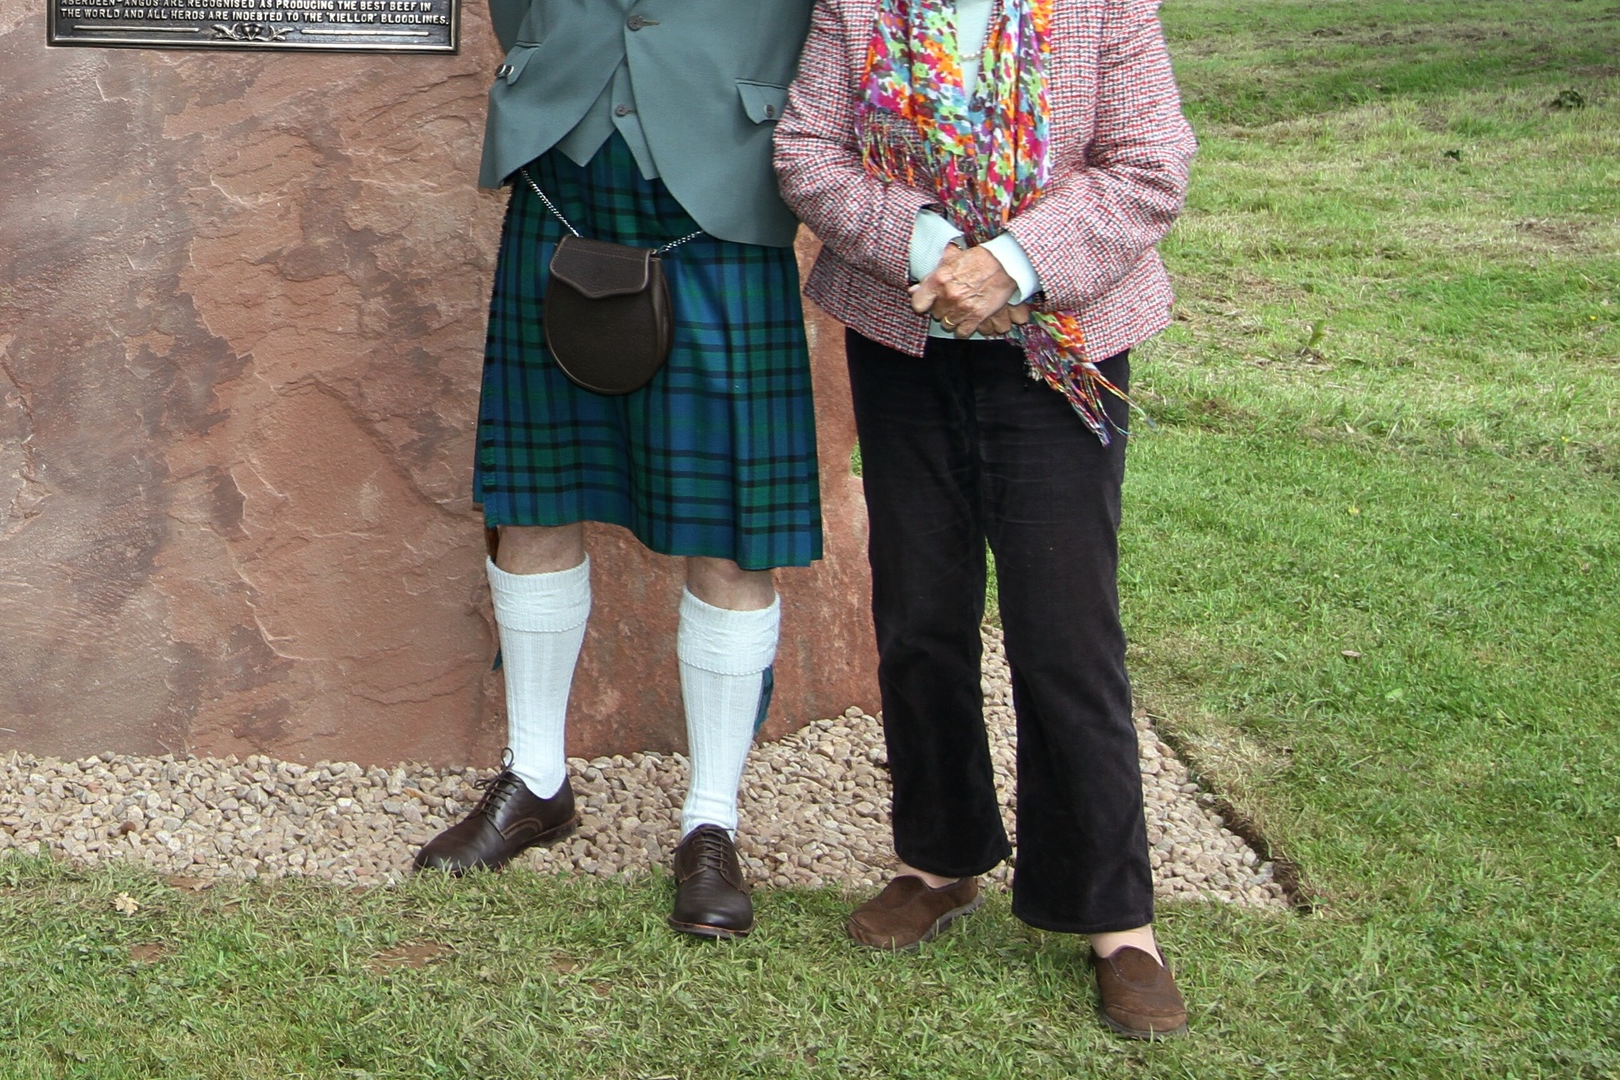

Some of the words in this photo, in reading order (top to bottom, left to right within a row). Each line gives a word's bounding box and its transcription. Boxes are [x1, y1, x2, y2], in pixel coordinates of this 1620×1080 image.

[260, 0, 272, 9] AS
[276, 0, 334, 10] PRODUCING
[338, 1, 357, 10] THE
[360, 1, 386, 11] BEST
[390, 2, 418, 11] BEEF
[420, 2, 431, 12] IN
[62, 8, 80, 18] THE
[84, 9, 120, 19] WORLD
[123, 10, 144, 19] AND
[147, 10, 168, 20] ALL
[170, 10, 204, 20] HERDS
[208, 11, 228, 21] ARE
[286, 12, 298, 22] TO
[302, 13, 322, 22] THE
[380, 14, 449, 26] BLOODLINES.
